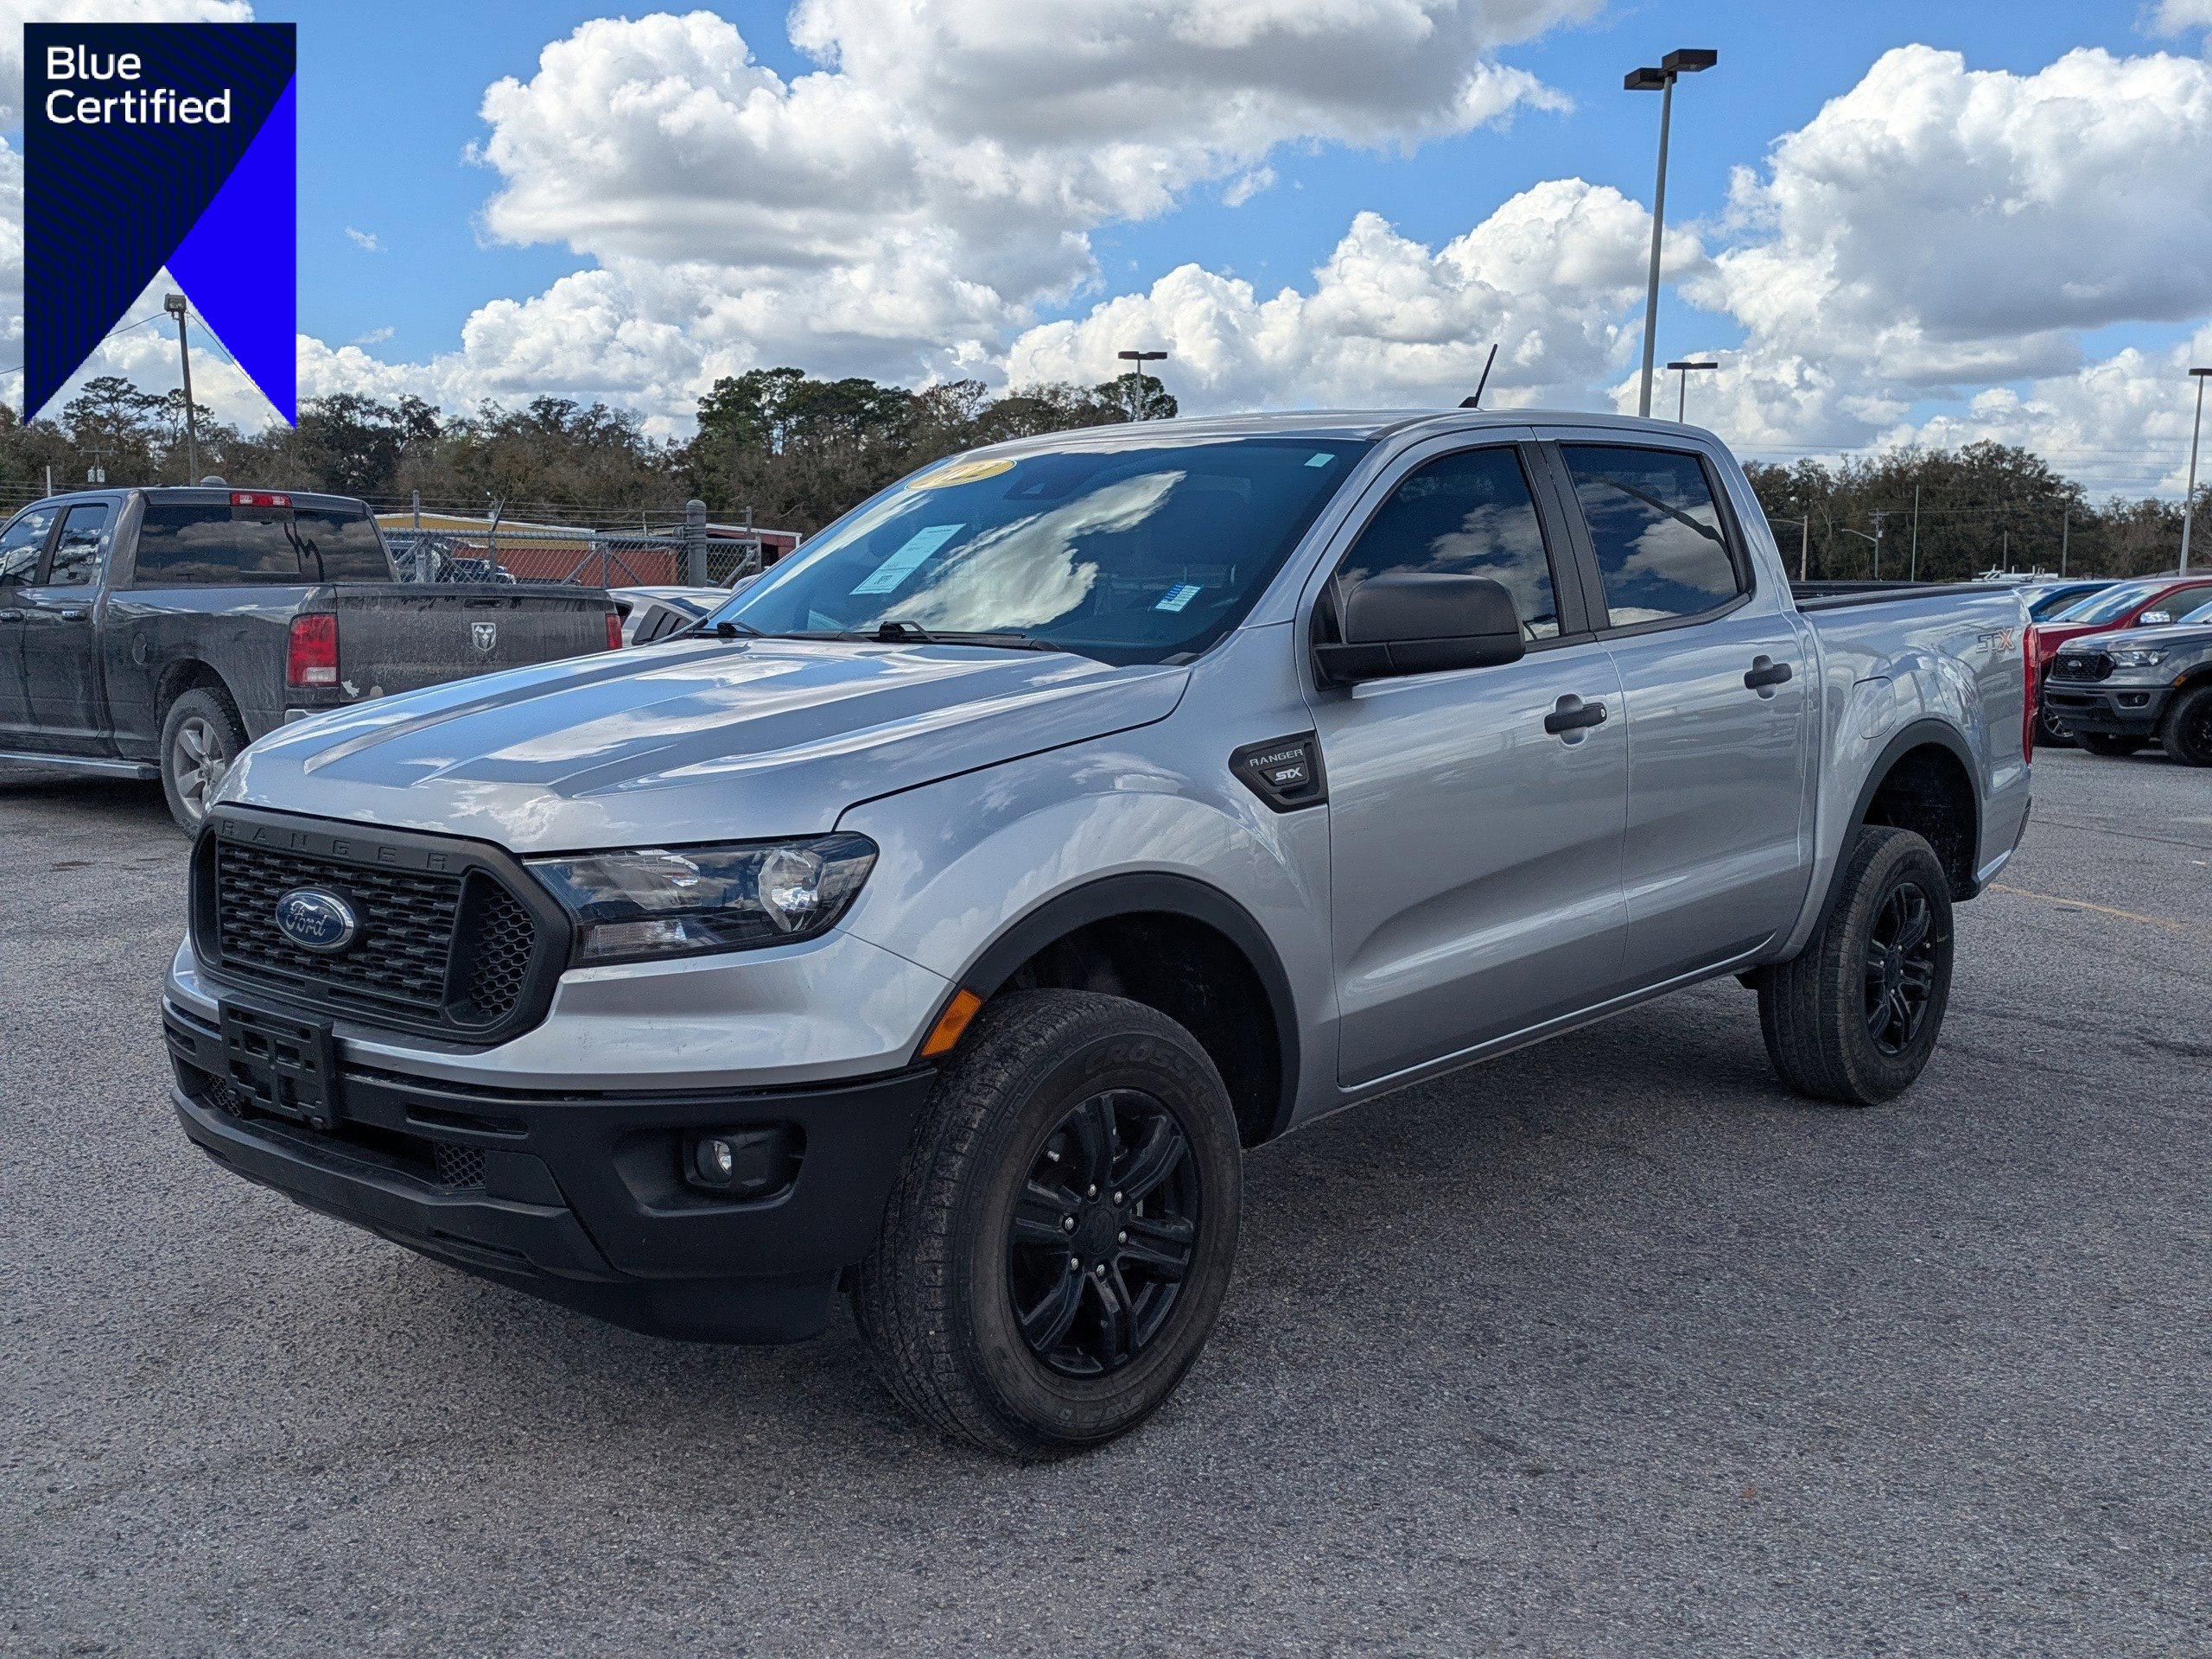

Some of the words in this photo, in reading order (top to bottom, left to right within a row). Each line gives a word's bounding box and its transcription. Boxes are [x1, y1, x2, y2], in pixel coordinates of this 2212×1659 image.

[1976, 626, 2015, 653] STX
[1249, 748, 1304, 767] RANGER
[1275, 766, 1303, 781] STX
[221, 819, 450, 871] RANGER
[285, 900, 327, 937] Ford
